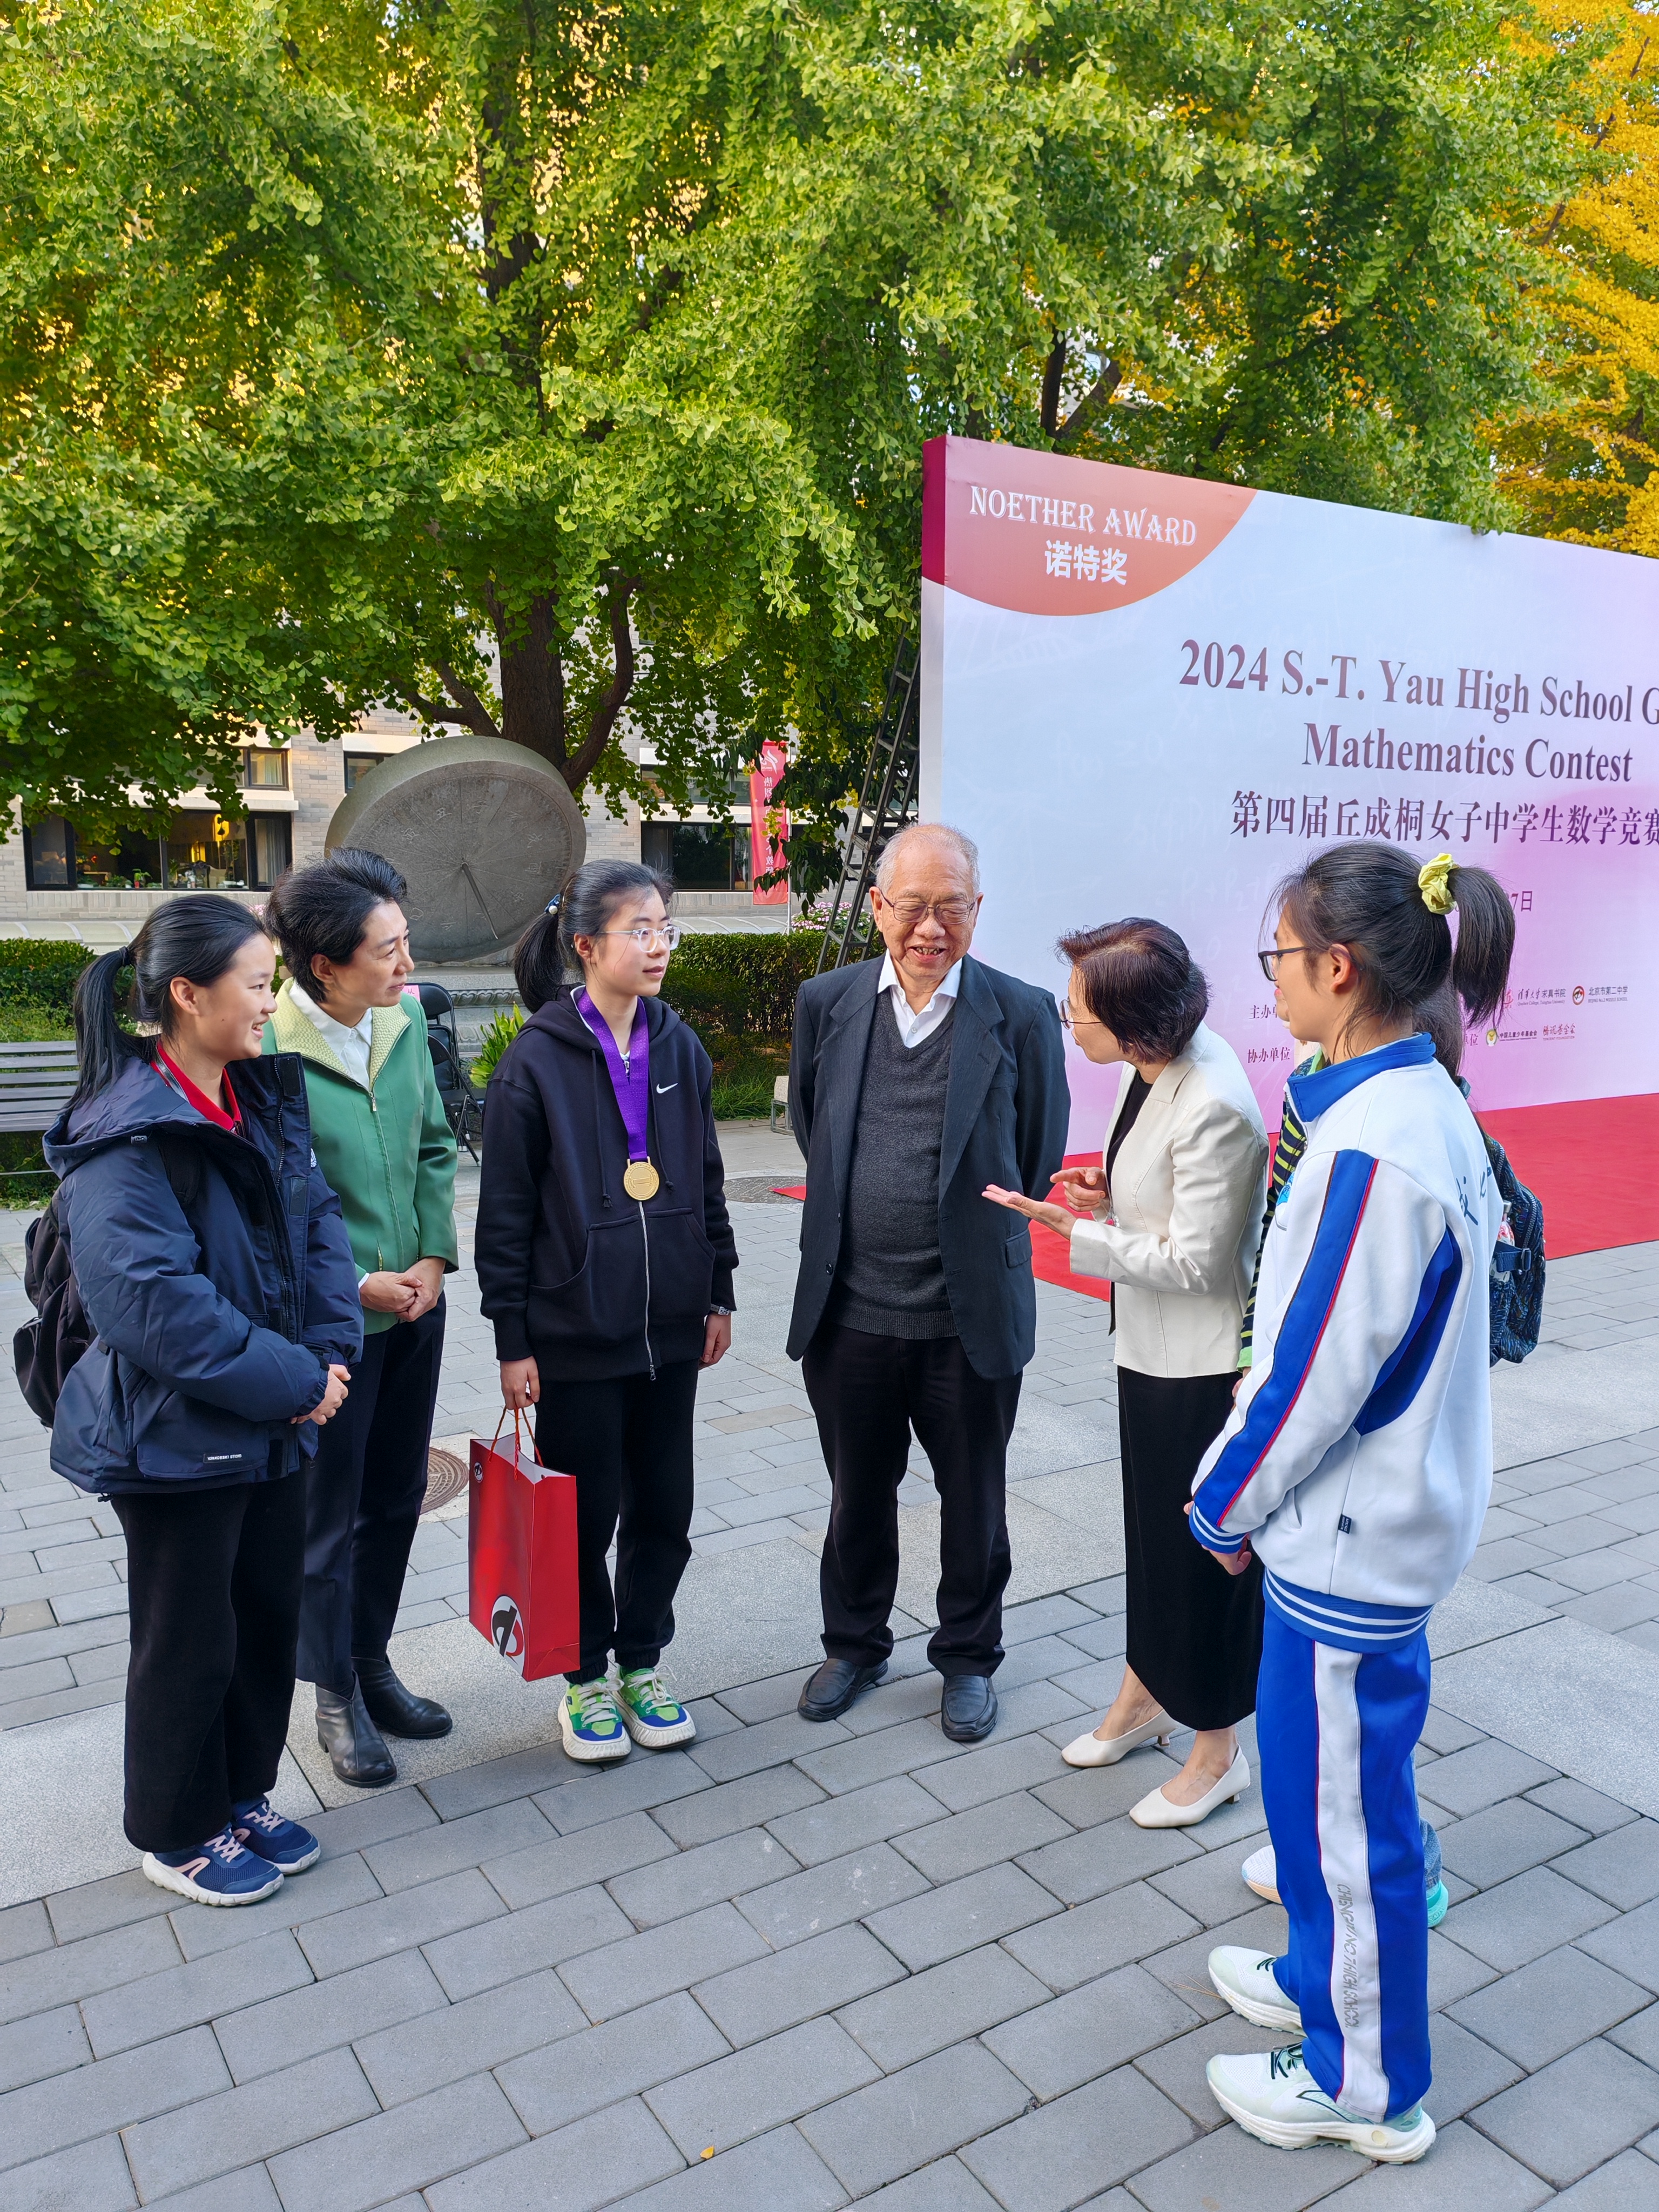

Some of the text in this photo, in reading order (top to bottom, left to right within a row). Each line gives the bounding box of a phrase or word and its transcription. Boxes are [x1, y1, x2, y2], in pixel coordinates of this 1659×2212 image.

[969, 485, 1197, 546] NOETHER AWARD
[1044, 539, 1128, 585] 诺特奖
[1179, 639, 1269, 691] 2024
[1379, 659, 1444, 706] Yau
[1455, 667, 1529, 723] High
[1540, 676, 1633, 722] School
[1301, 723, 1633, 782] Mathematics Contest
[1588, 985, 1628, 995] 北京市第二中学
[1247, 1047, 1290, 1063] 协办单位
[1343, 1961, 1358, 1991] HIGH
[1343, 1990, 1360, 2028] SCHOOL
